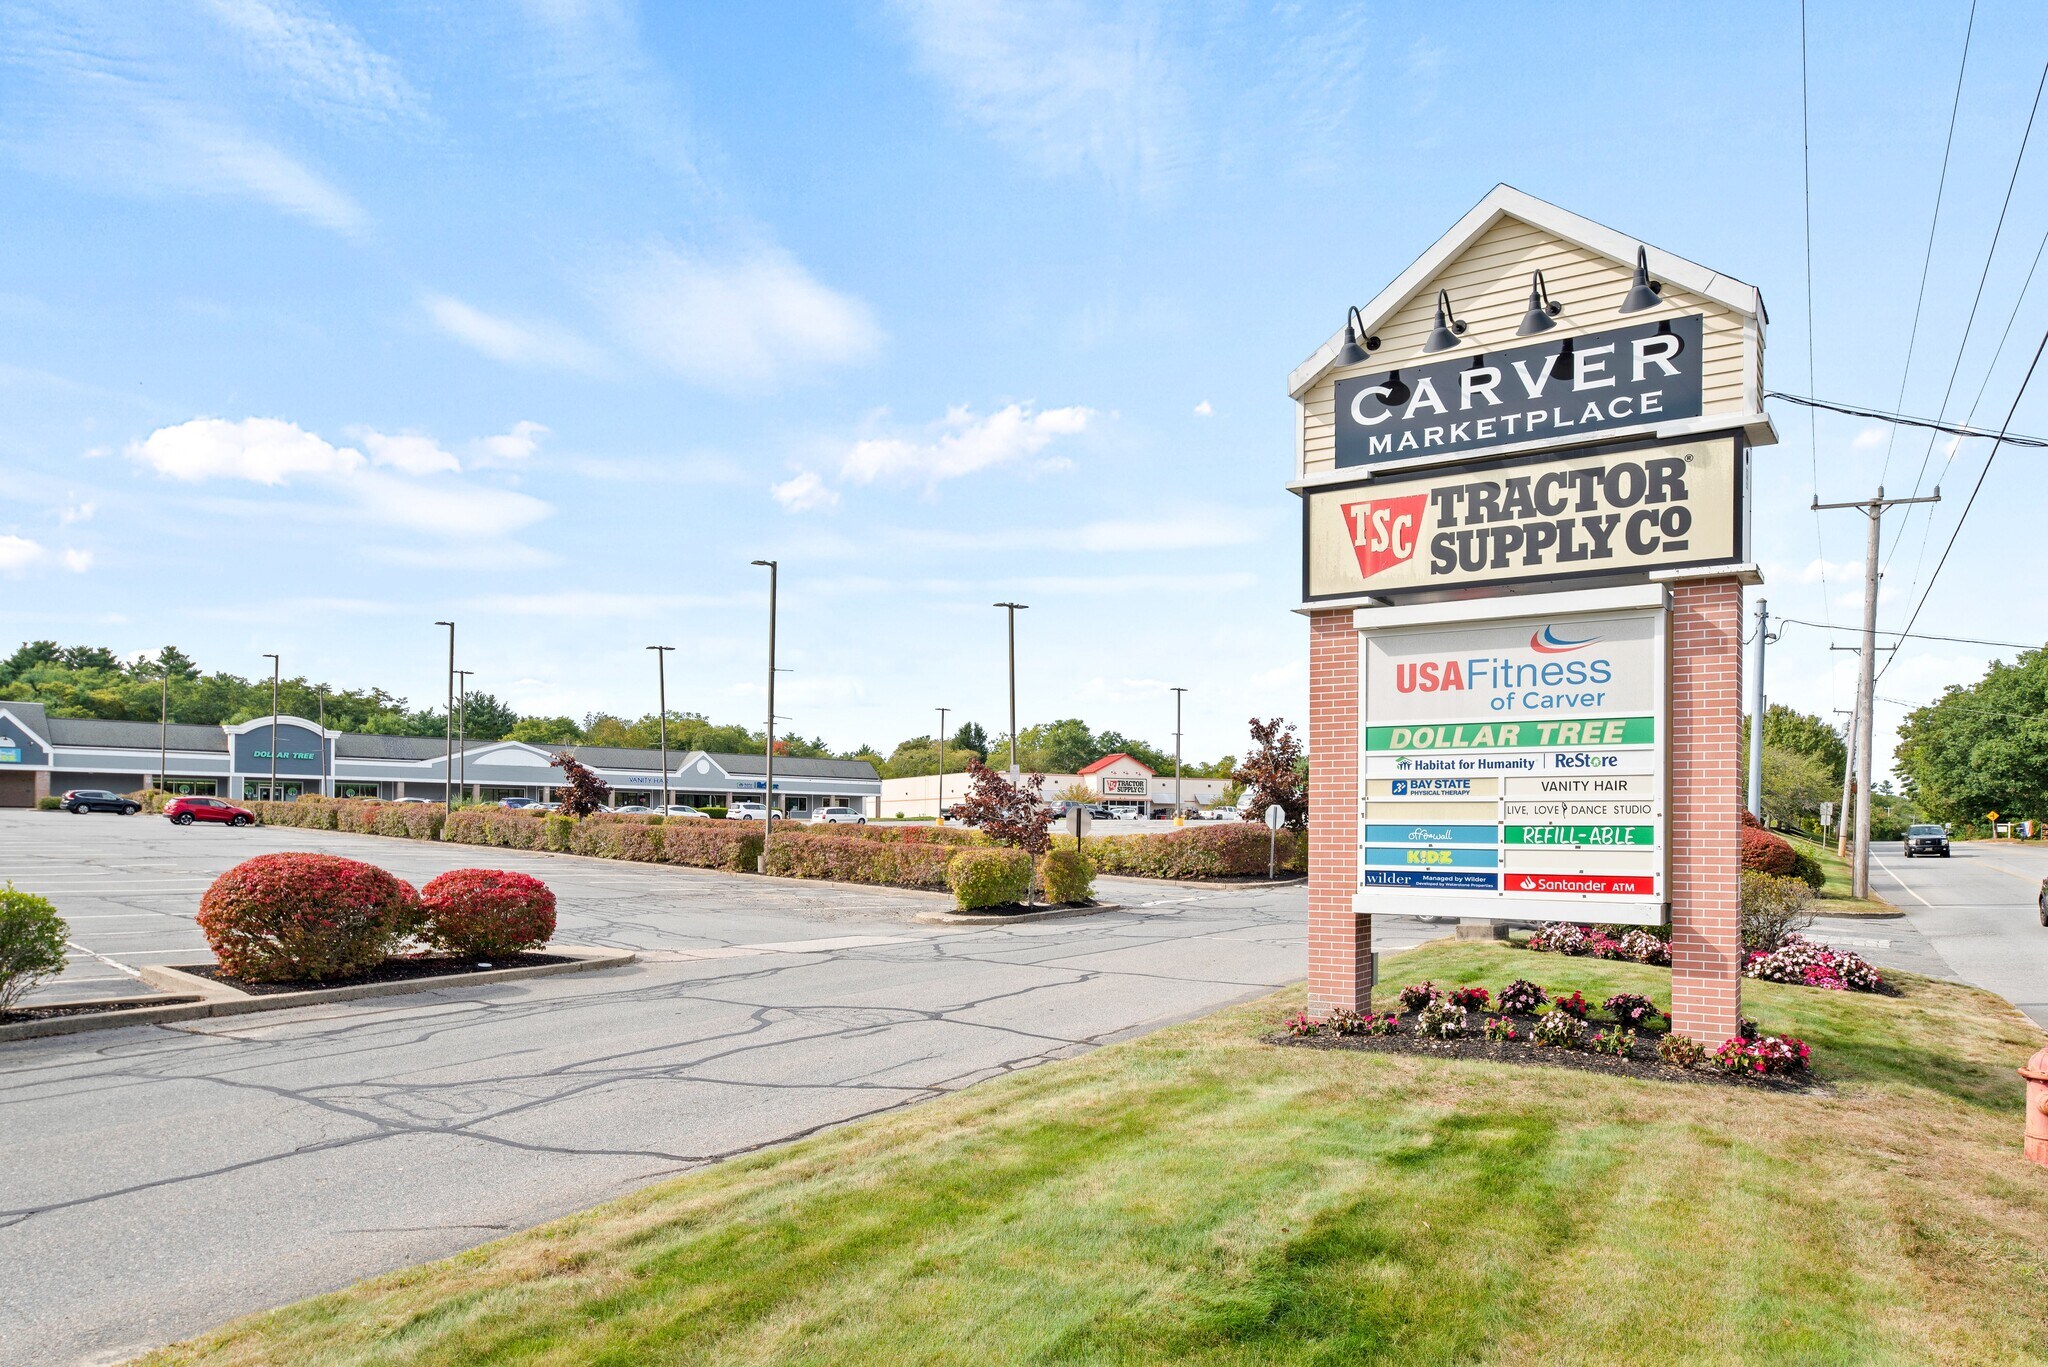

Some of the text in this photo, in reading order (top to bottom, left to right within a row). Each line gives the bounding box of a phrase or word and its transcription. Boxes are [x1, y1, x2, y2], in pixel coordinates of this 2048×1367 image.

[1350, 334, 1682, 426] CARVER
[1369, 389, 1664, 455] MARKETPLACE
[1430, 457, 1688, 528] TRACTOR
[1350, 504, 1413, 559] TSC
[1430, 512, 1621, 575] SUPPLY
[1491, 692, 1605, 711] of Carver
[1389, 720, 1626, 749] DOLLAR TREE
[253, 751, 315, 760] DOLAR TREE
[1555, 753, 1618, 768] ReStore
[1415, 758, 1535, 771] Habitat for Humanity
[629, 776, 652, 784] VANITY
[1411, 780, 1470, 788] BAY STATE
[1541, 780, 1628, 791] VANITY HAIR
[1507, 805, 1651, 815] LIVE, LOVE DANCE STUDIO
[1367, 872, 1411, 884] wilder
[1538, 879, 1635, 892] Santander ATM
